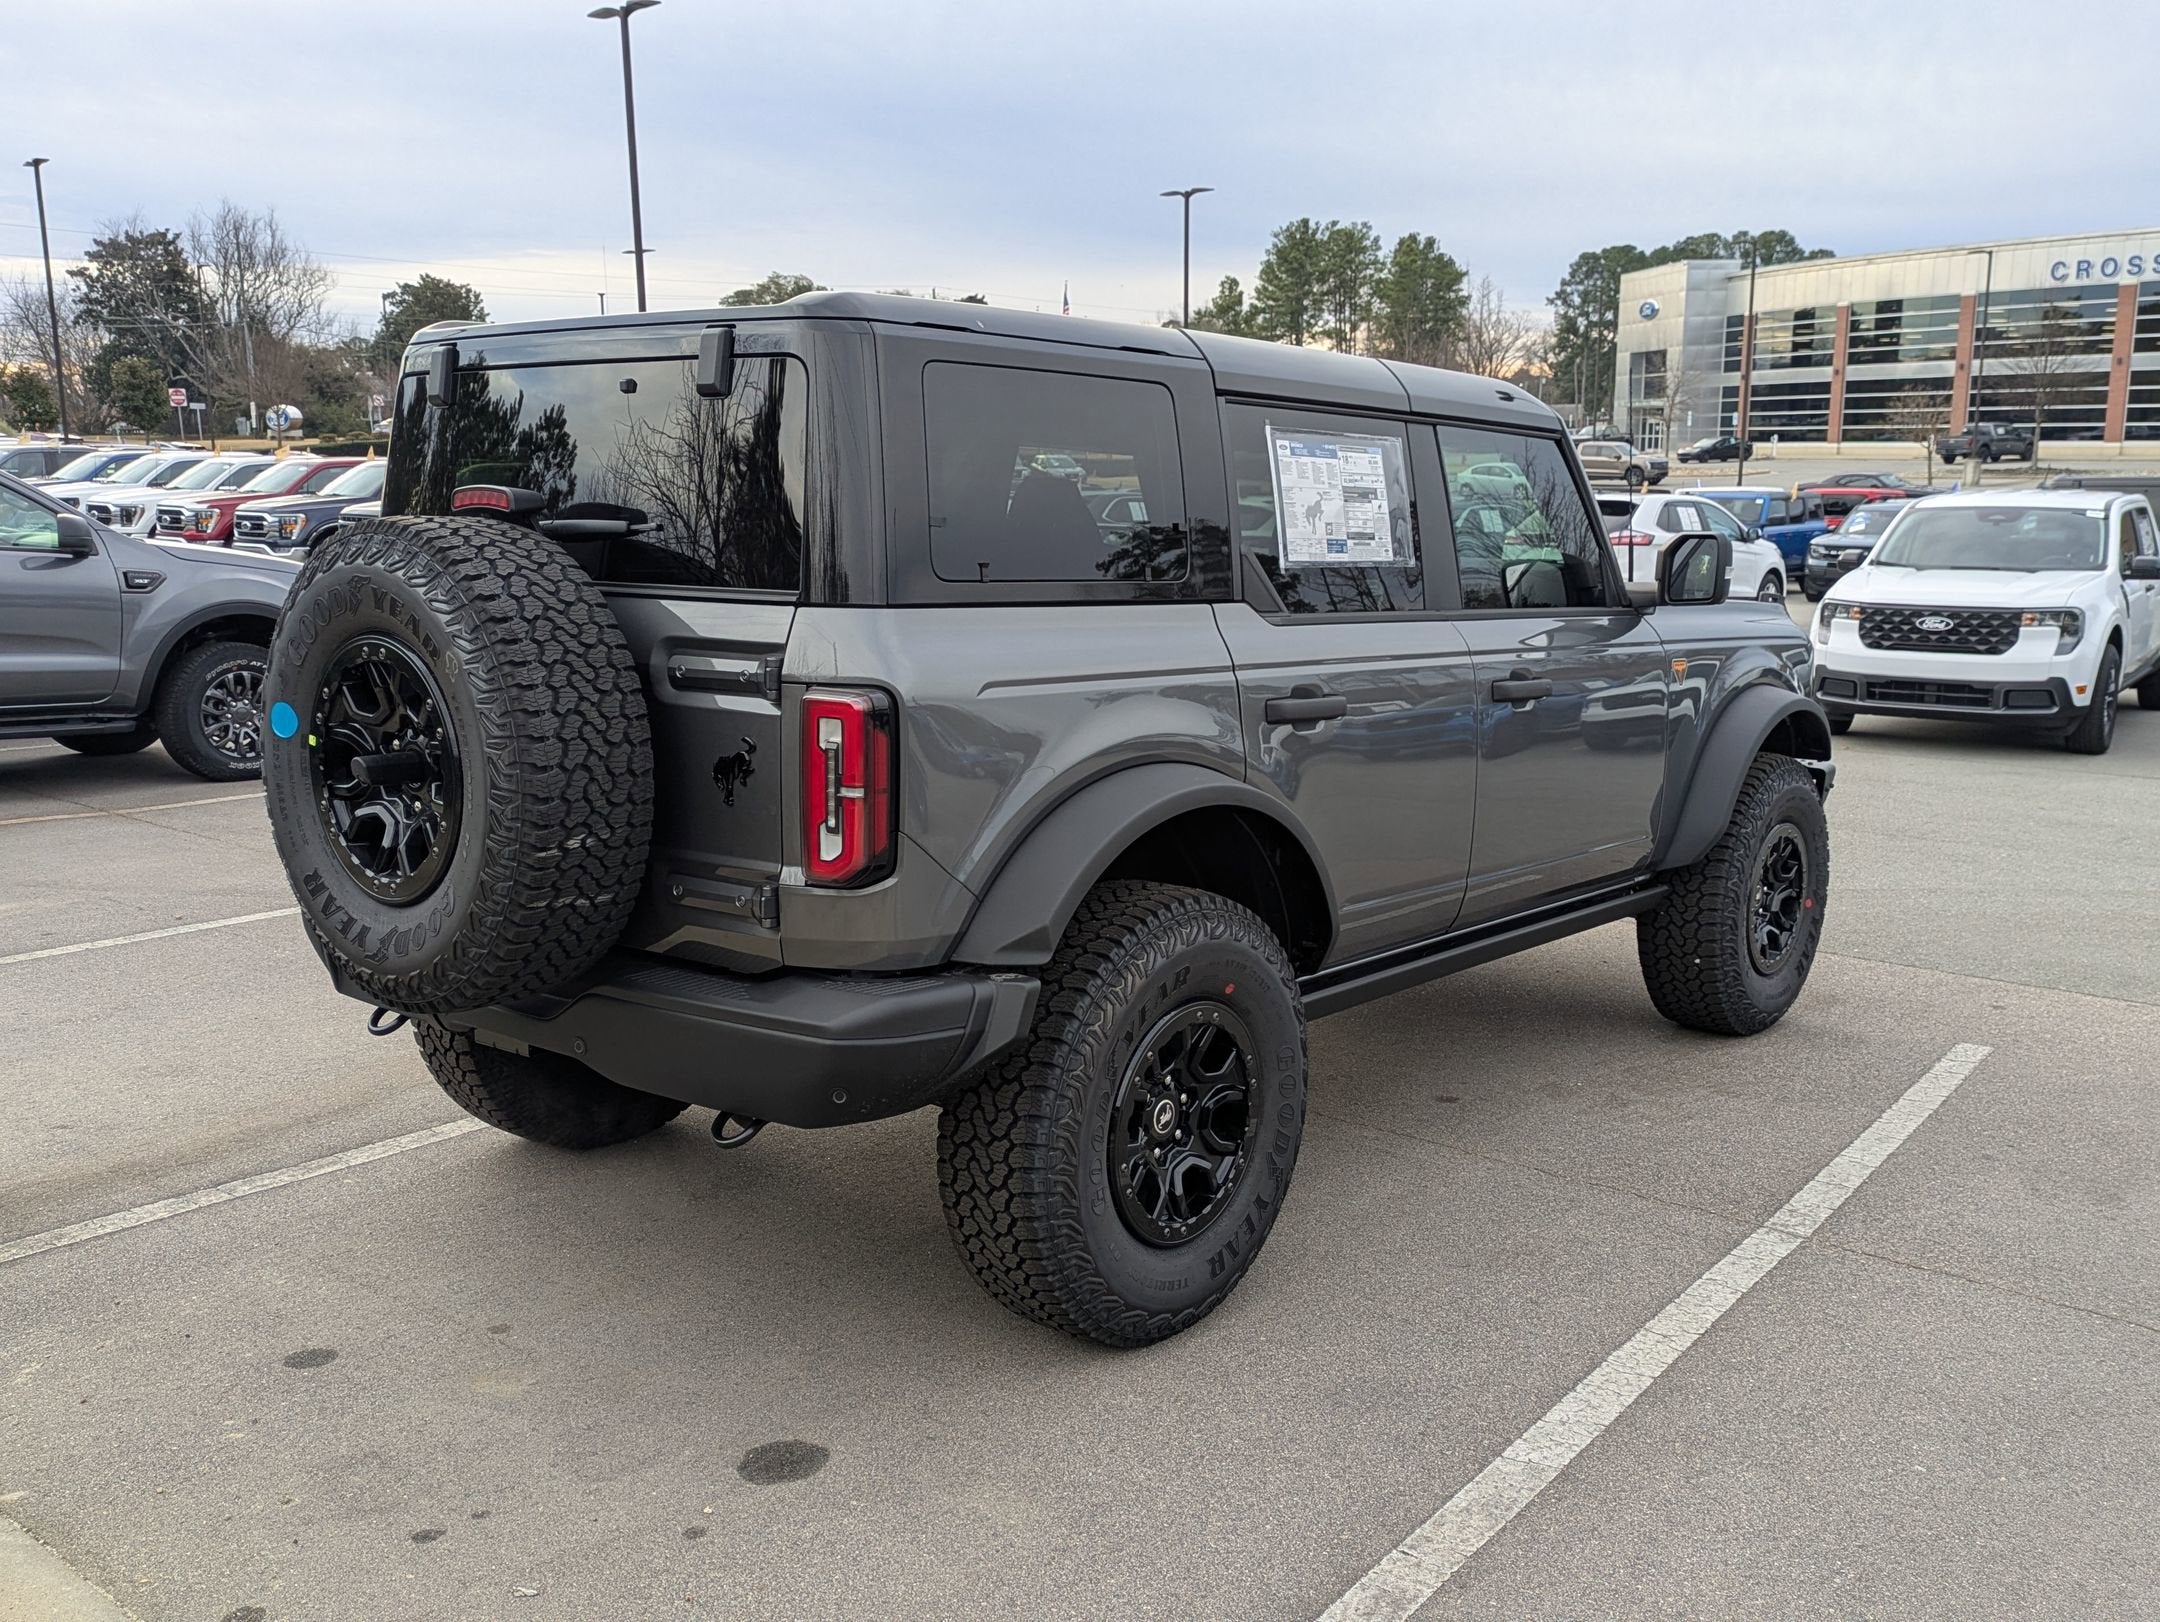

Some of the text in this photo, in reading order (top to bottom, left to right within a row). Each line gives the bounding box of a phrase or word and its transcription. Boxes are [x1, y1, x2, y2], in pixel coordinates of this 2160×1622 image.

[287, 575, 441, 666] GOODYEAR
[1919, 618, 1950, 630] Ford
[303, 867, 456, 962] GOODYEAR
[1206, 1047, 1297, 1280] GOODYEAR
